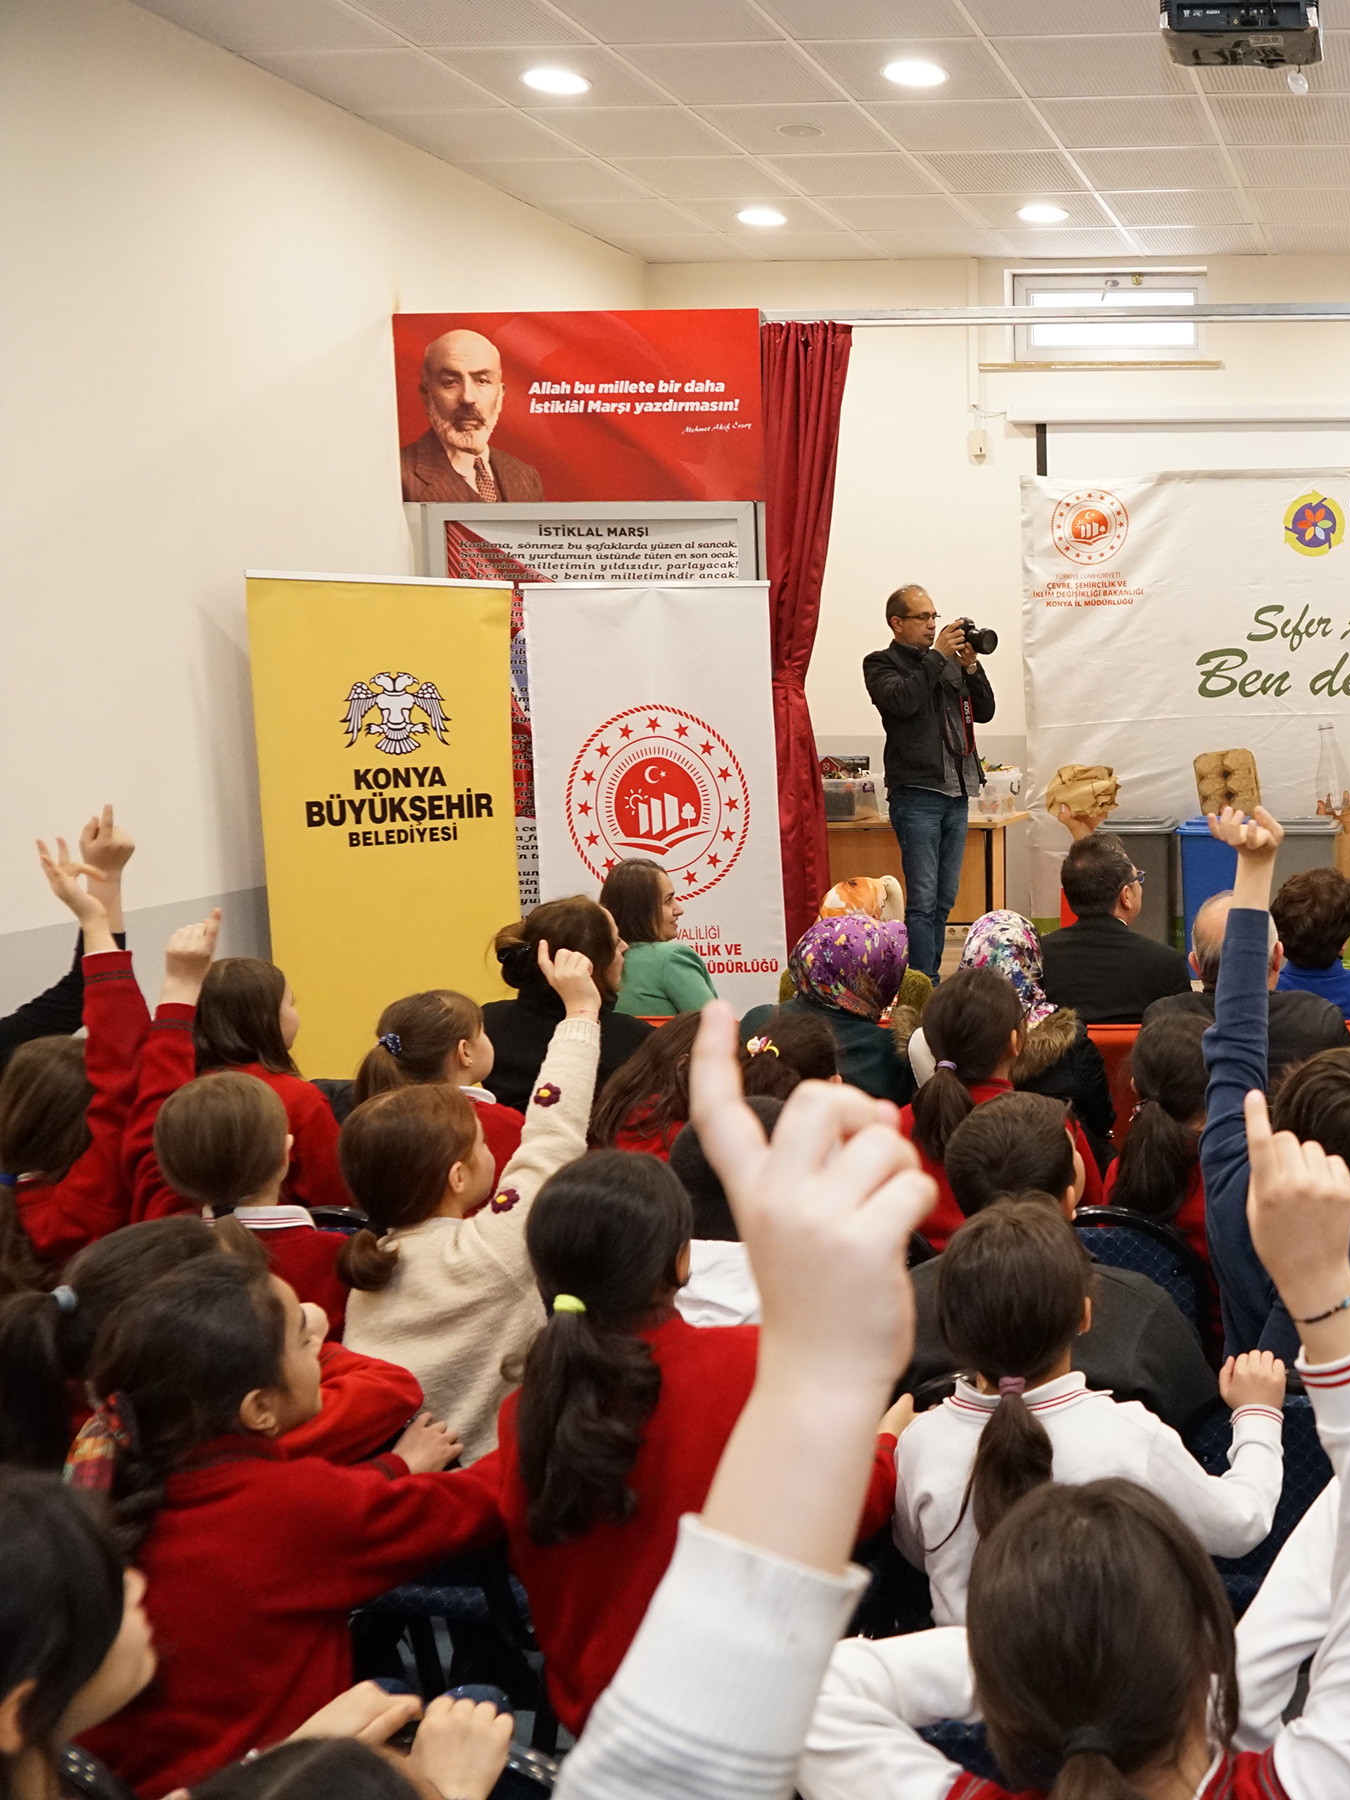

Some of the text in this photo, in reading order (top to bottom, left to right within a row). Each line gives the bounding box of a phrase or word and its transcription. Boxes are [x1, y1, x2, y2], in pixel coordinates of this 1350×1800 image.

[528, 380, 725, 395] Allah bu millete bir daha
[529, 399, 740, 414] İstiklâl Marşı yazdırmasın!
[539, 524, 649, 538] İSTİKLAL MARŞI
[517, 541, 564, 550] sönmez
[567, 542, 583, 550] bu
[586, 542, 648, 552] şafaklarda
[650, 541, 682, 551] yüzen
[685, 541, 695, 549] al
[460, 551, 525, 560] Sönmeden
[528, 553, 593, 561] yurdumun
[596, 552, 641, 560] üstünde
[644, 552, 672, 560] tüten
[476, 561, 519, 569] benim
[524, 562, 596, 570] milletimin
[667, 561, 739, 571] parlayacak!
[564, 572, 605, 580] benim
[611, 572, 694, 580] milletimindir
[1075, 581, 1116, 590] ŞEHİRCİLİK
[1117, 580, 1128, 588] VE
[1032, 589, 1055, 598] İKLİM
[1102, 587, 1144, 597] BAKANLIĞI
[1074, 599, 1082, 607] İL
[1084, 598, 1134, 607] MÜDÜRLÜĞÜ
[1246, 603, 1333, 651] Sıfır
[1196, 648, 1292, 698] Ben
[354, 766, 447, 790] KONYA
[306, 788, 494, 828] BÜYÜKŞEHİR
[349, 822, 458, 848] BELEDİYESİ
[677, 926, 720, 940] VALİLİĞİ
[689, 942, 742, 956] İLİK VE
[706, 959, 779, 974] ÜDÜRLÜĞÜ
